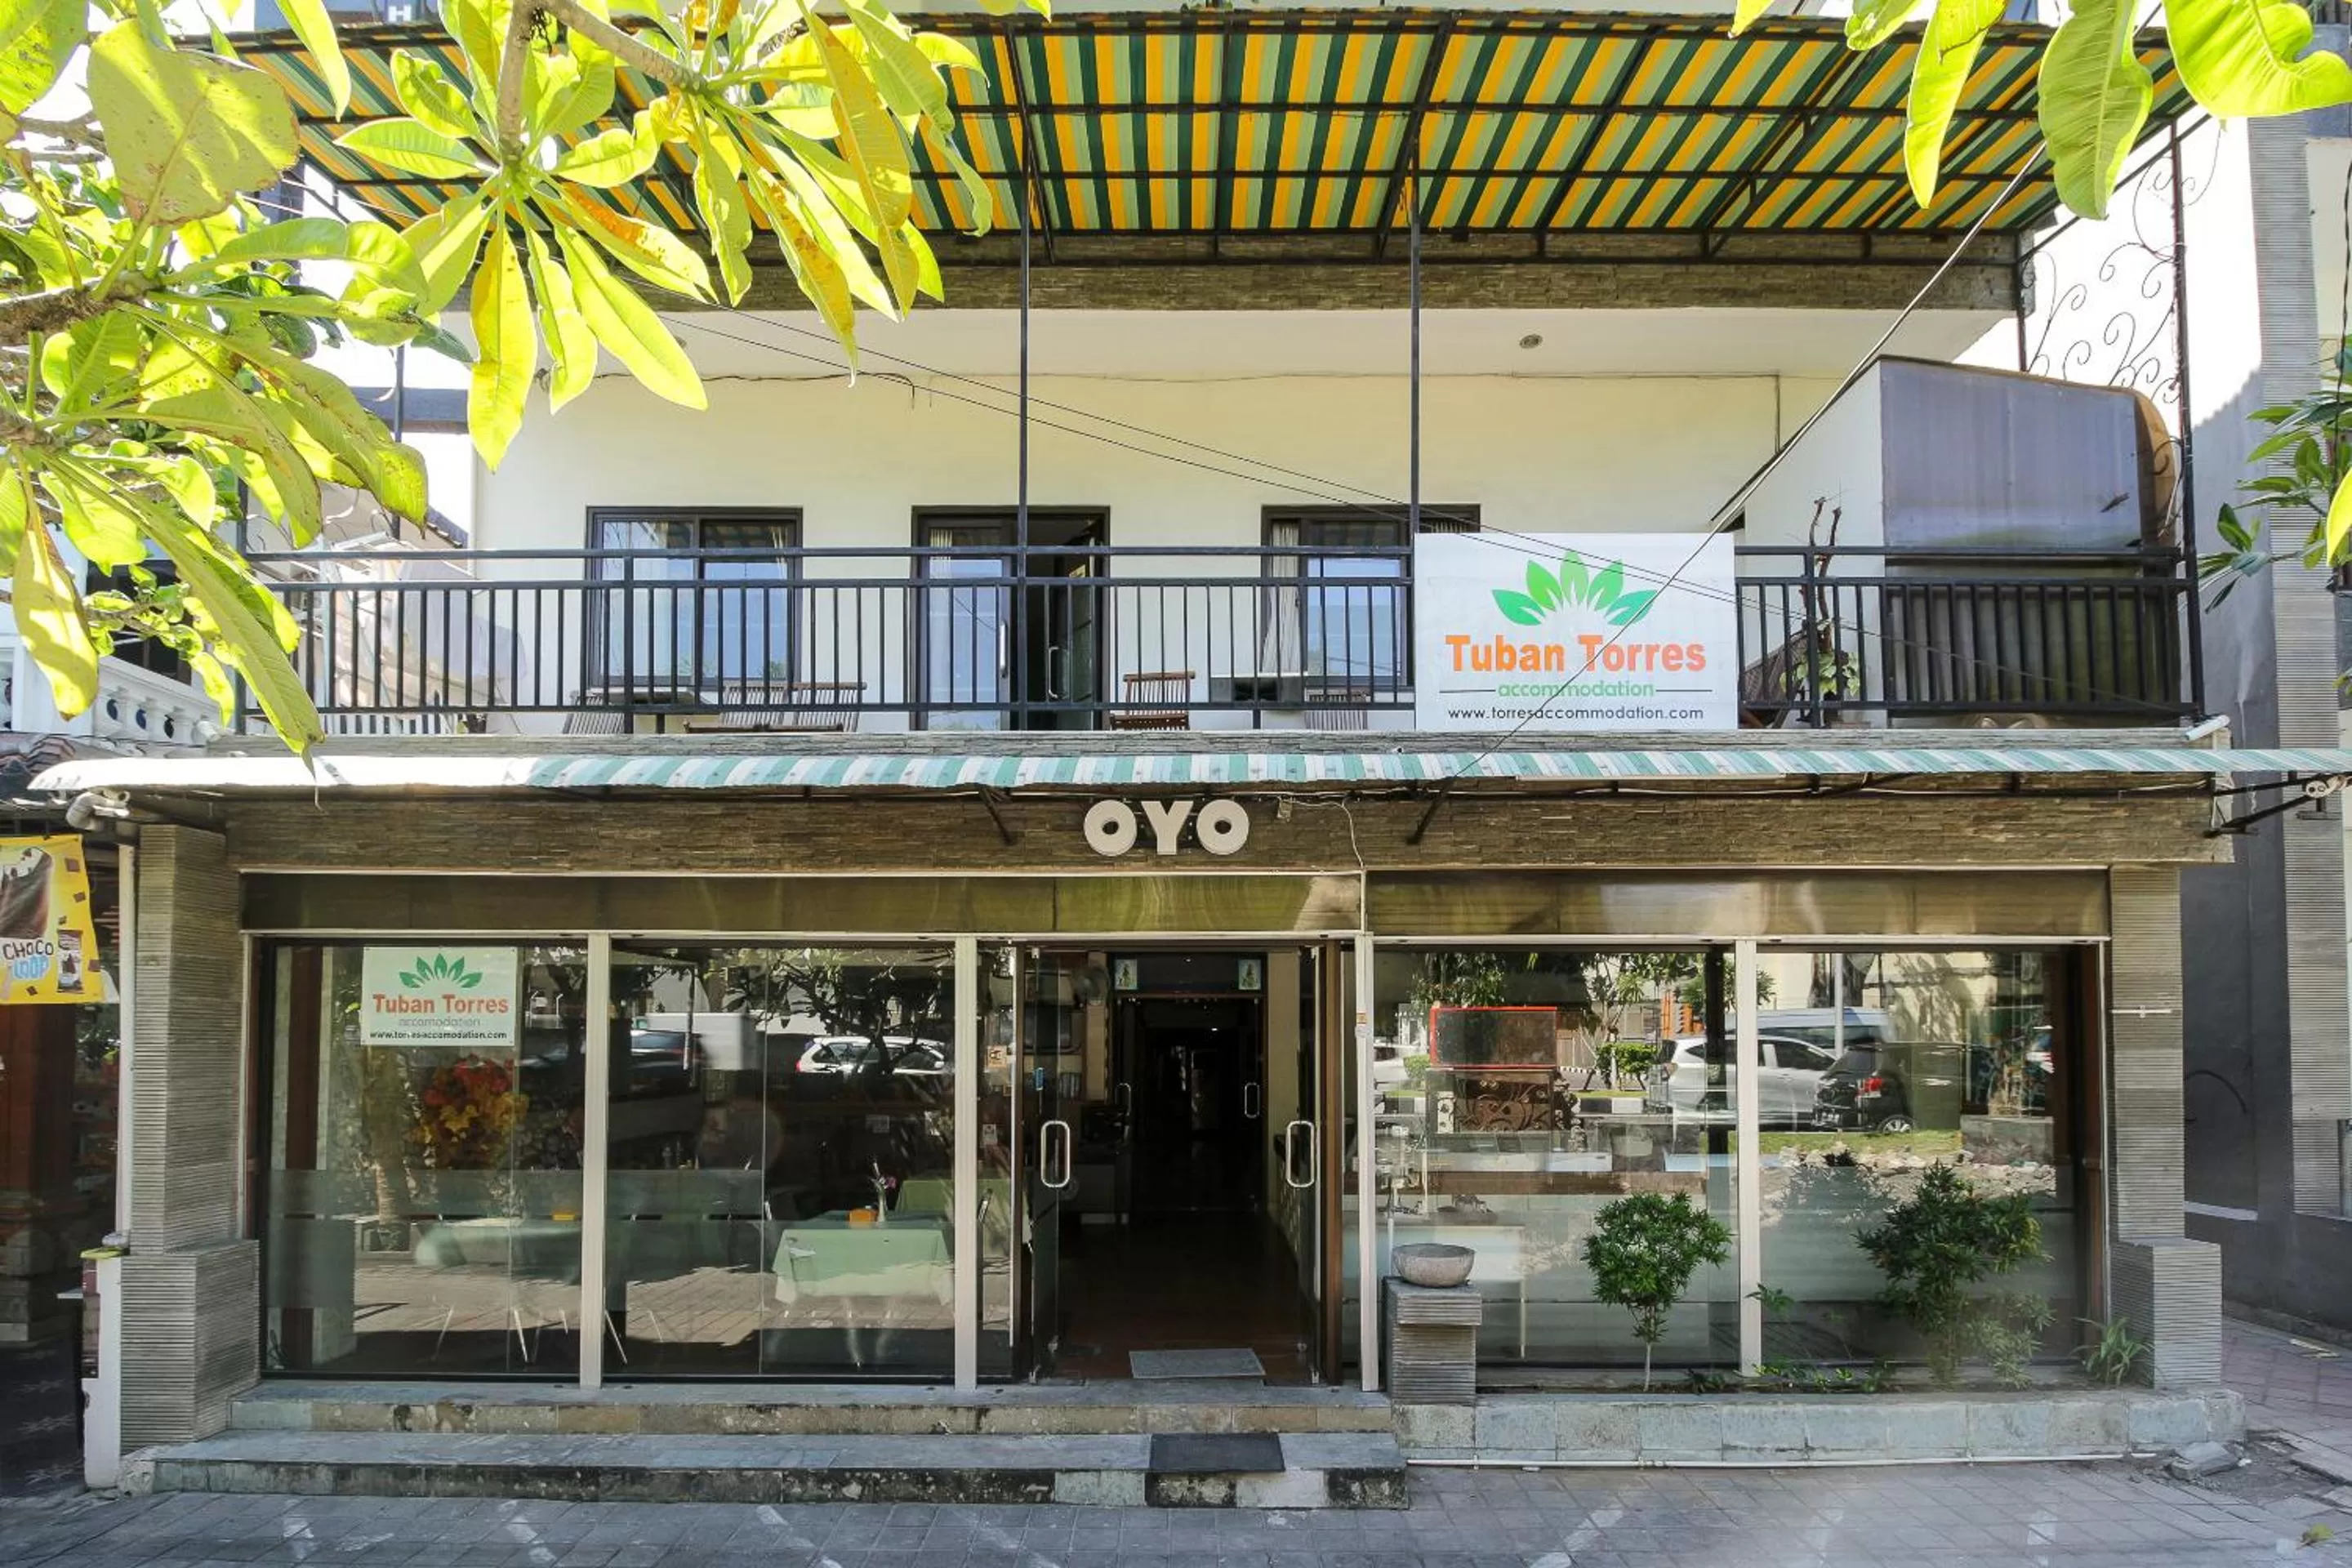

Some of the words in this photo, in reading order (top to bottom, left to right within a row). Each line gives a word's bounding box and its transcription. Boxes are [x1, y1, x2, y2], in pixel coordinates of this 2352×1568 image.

[1446, 635, 1565, 672] Tuban
[1577, 635, 1707, 672] Torres
[1498, 680, 1655, 697] accommodation
[1448, 706, 1704, 720] www.torresaccommodation.com
[1084, 799, 1250, 856] OYO
[2, 940, 54, 960] CHOCO
[372, 993, 435, 1013] Tuban
[442, 993, 510, 1013] Torres
